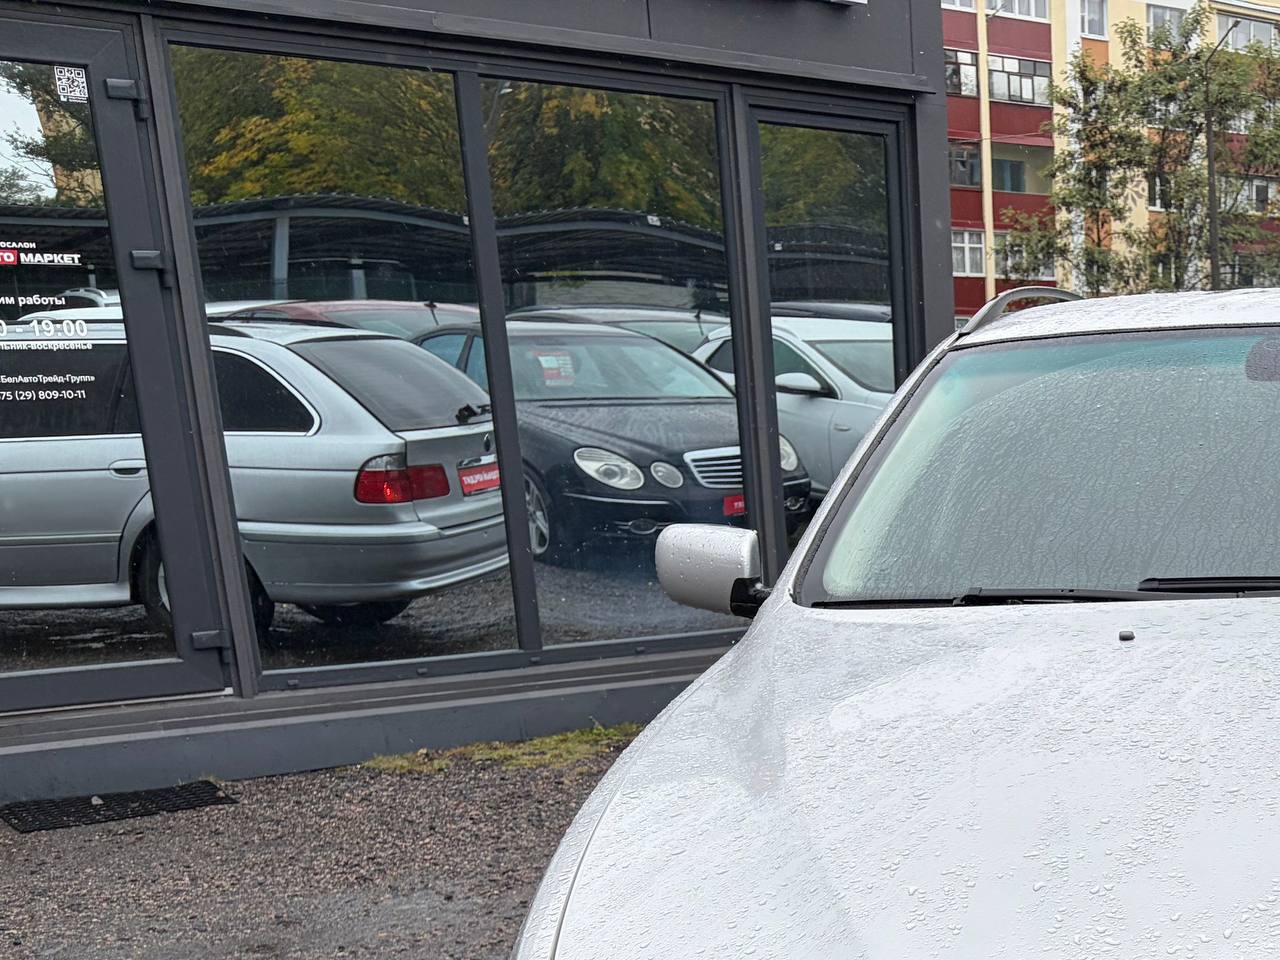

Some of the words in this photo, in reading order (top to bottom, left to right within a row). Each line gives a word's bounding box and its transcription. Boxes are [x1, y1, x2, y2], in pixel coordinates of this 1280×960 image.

[20, 252, 81, 263] МАРКЕТ
[18, 294, 66, 307] работы
[29, 319, 88, 337] 19:00
[0, 391, 13, 400] 75
[15, 390, 36, 401] (29)
[38, 390, 86, 400] 809-10-11
